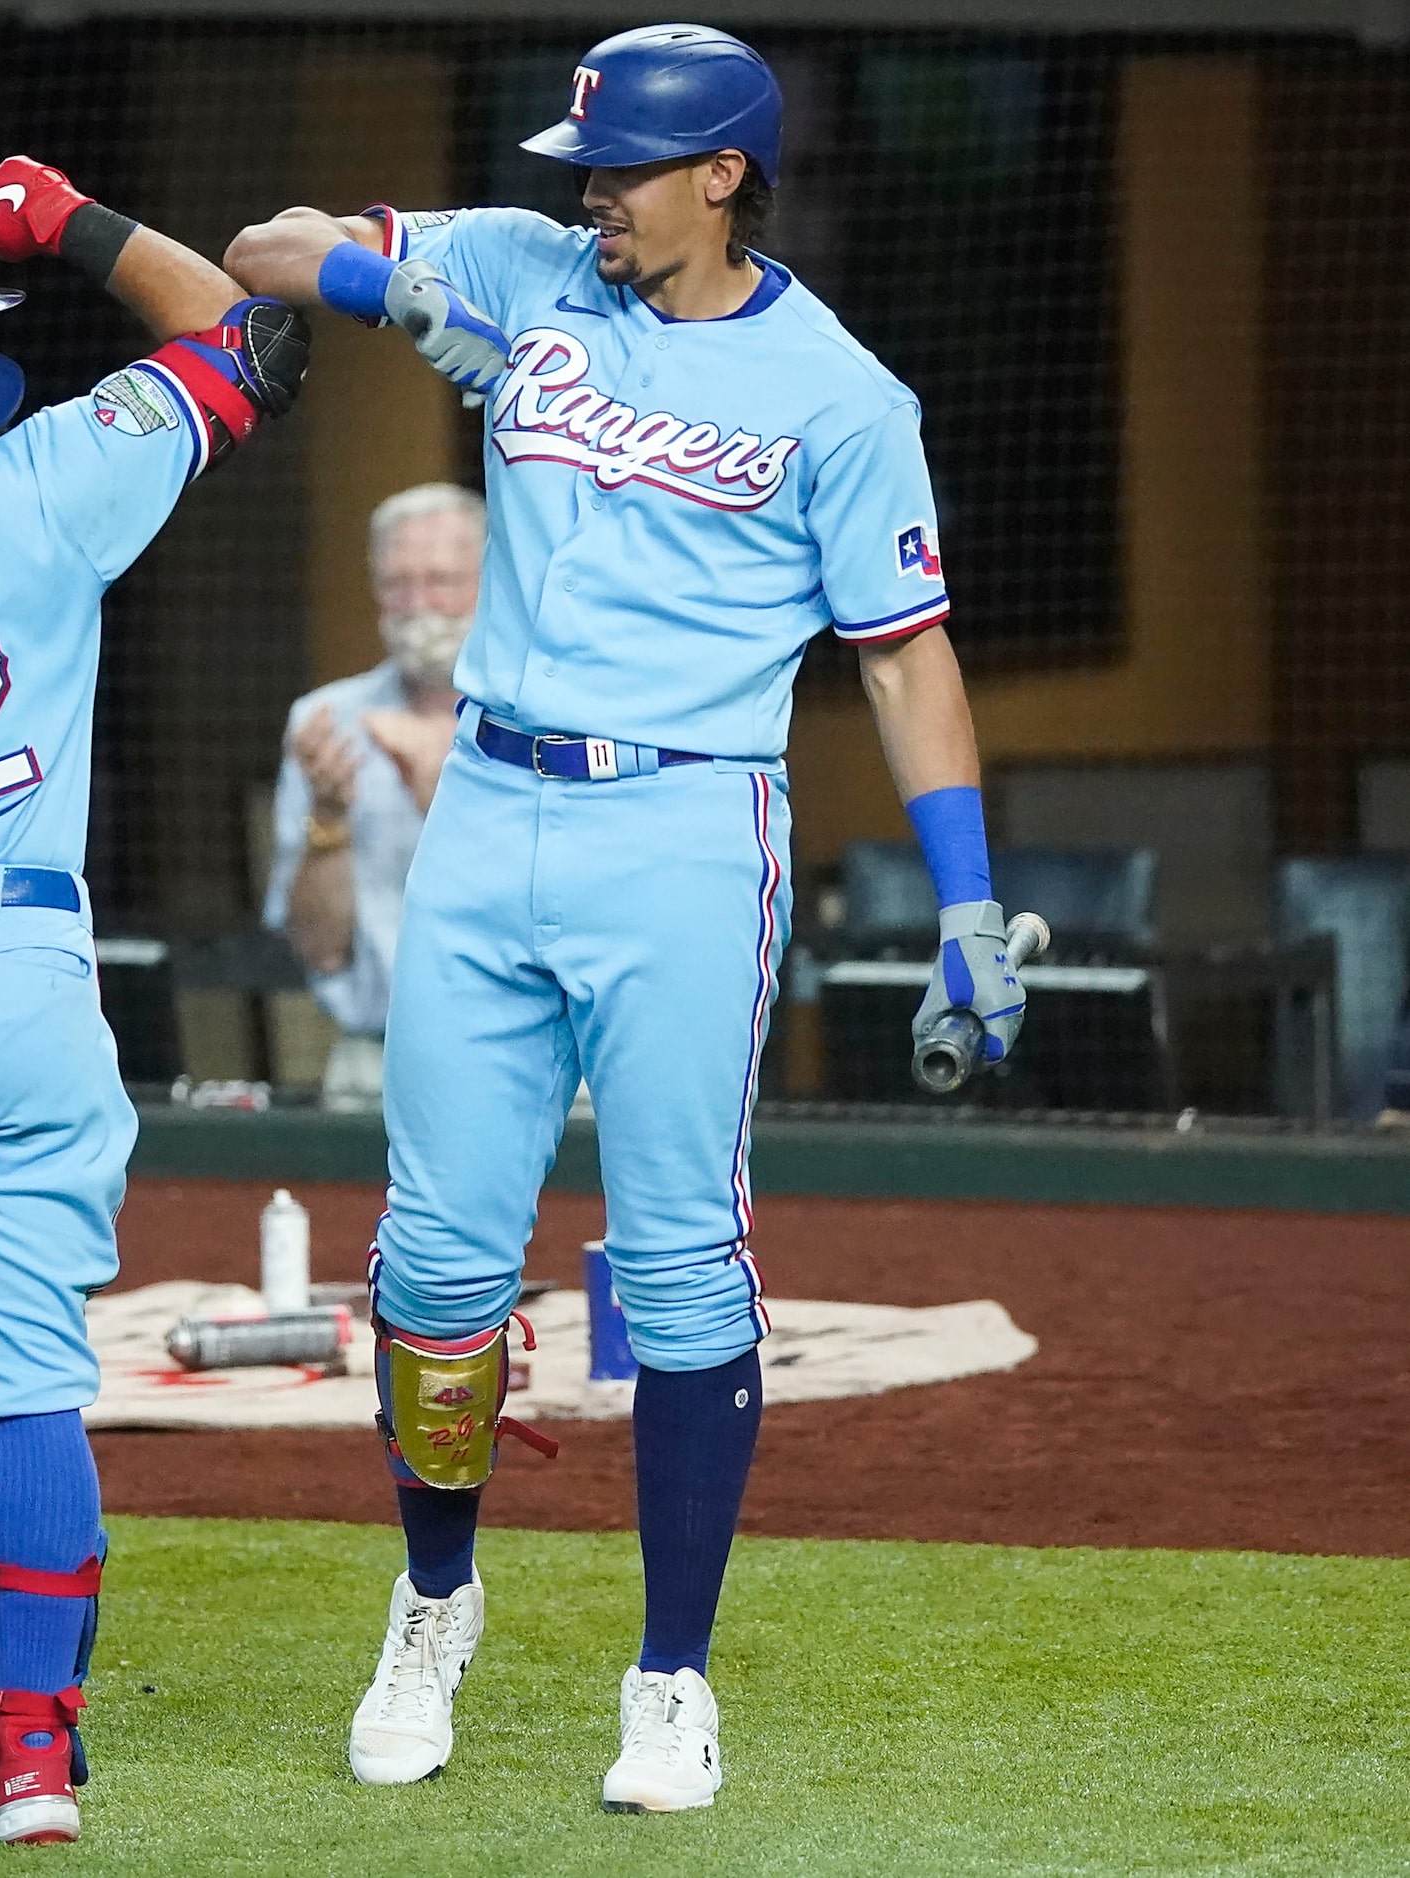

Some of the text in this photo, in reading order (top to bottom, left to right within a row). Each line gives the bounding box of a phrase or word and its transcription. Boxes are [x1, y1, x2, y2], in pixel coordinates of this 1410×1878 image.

[570, 65, 600, 120] T
[147, 387, 176, 424] INAUGURAL
[492, 327, 800, 504] Rangers
[592, 744, 609, 767] 11
